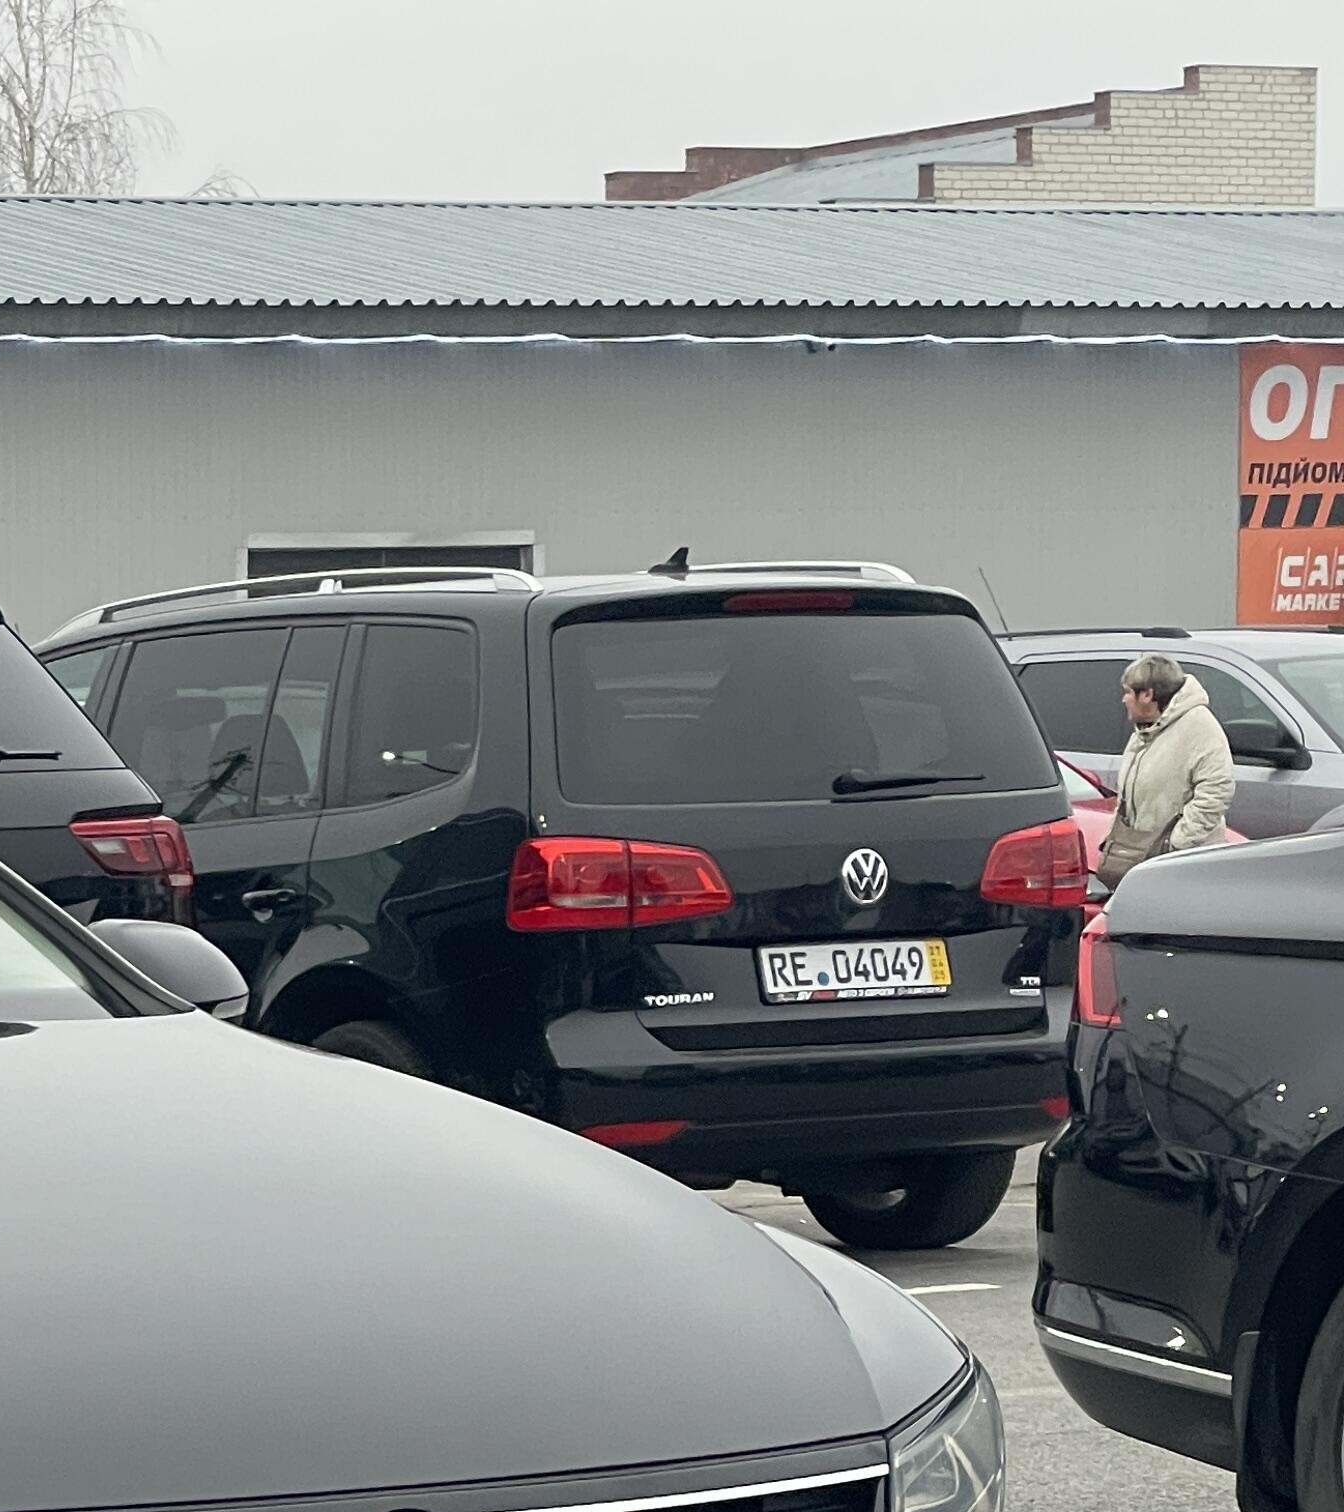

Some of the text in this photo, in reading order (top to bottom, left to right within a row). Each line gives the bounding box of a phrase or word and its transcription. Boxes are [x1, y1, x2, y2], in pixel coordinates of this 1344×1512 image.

[1276, 593, 1344, 612] MARKE
[768, 945, 924, 987] RE 04049
[644, 992, 714, 1006] TOURAN
